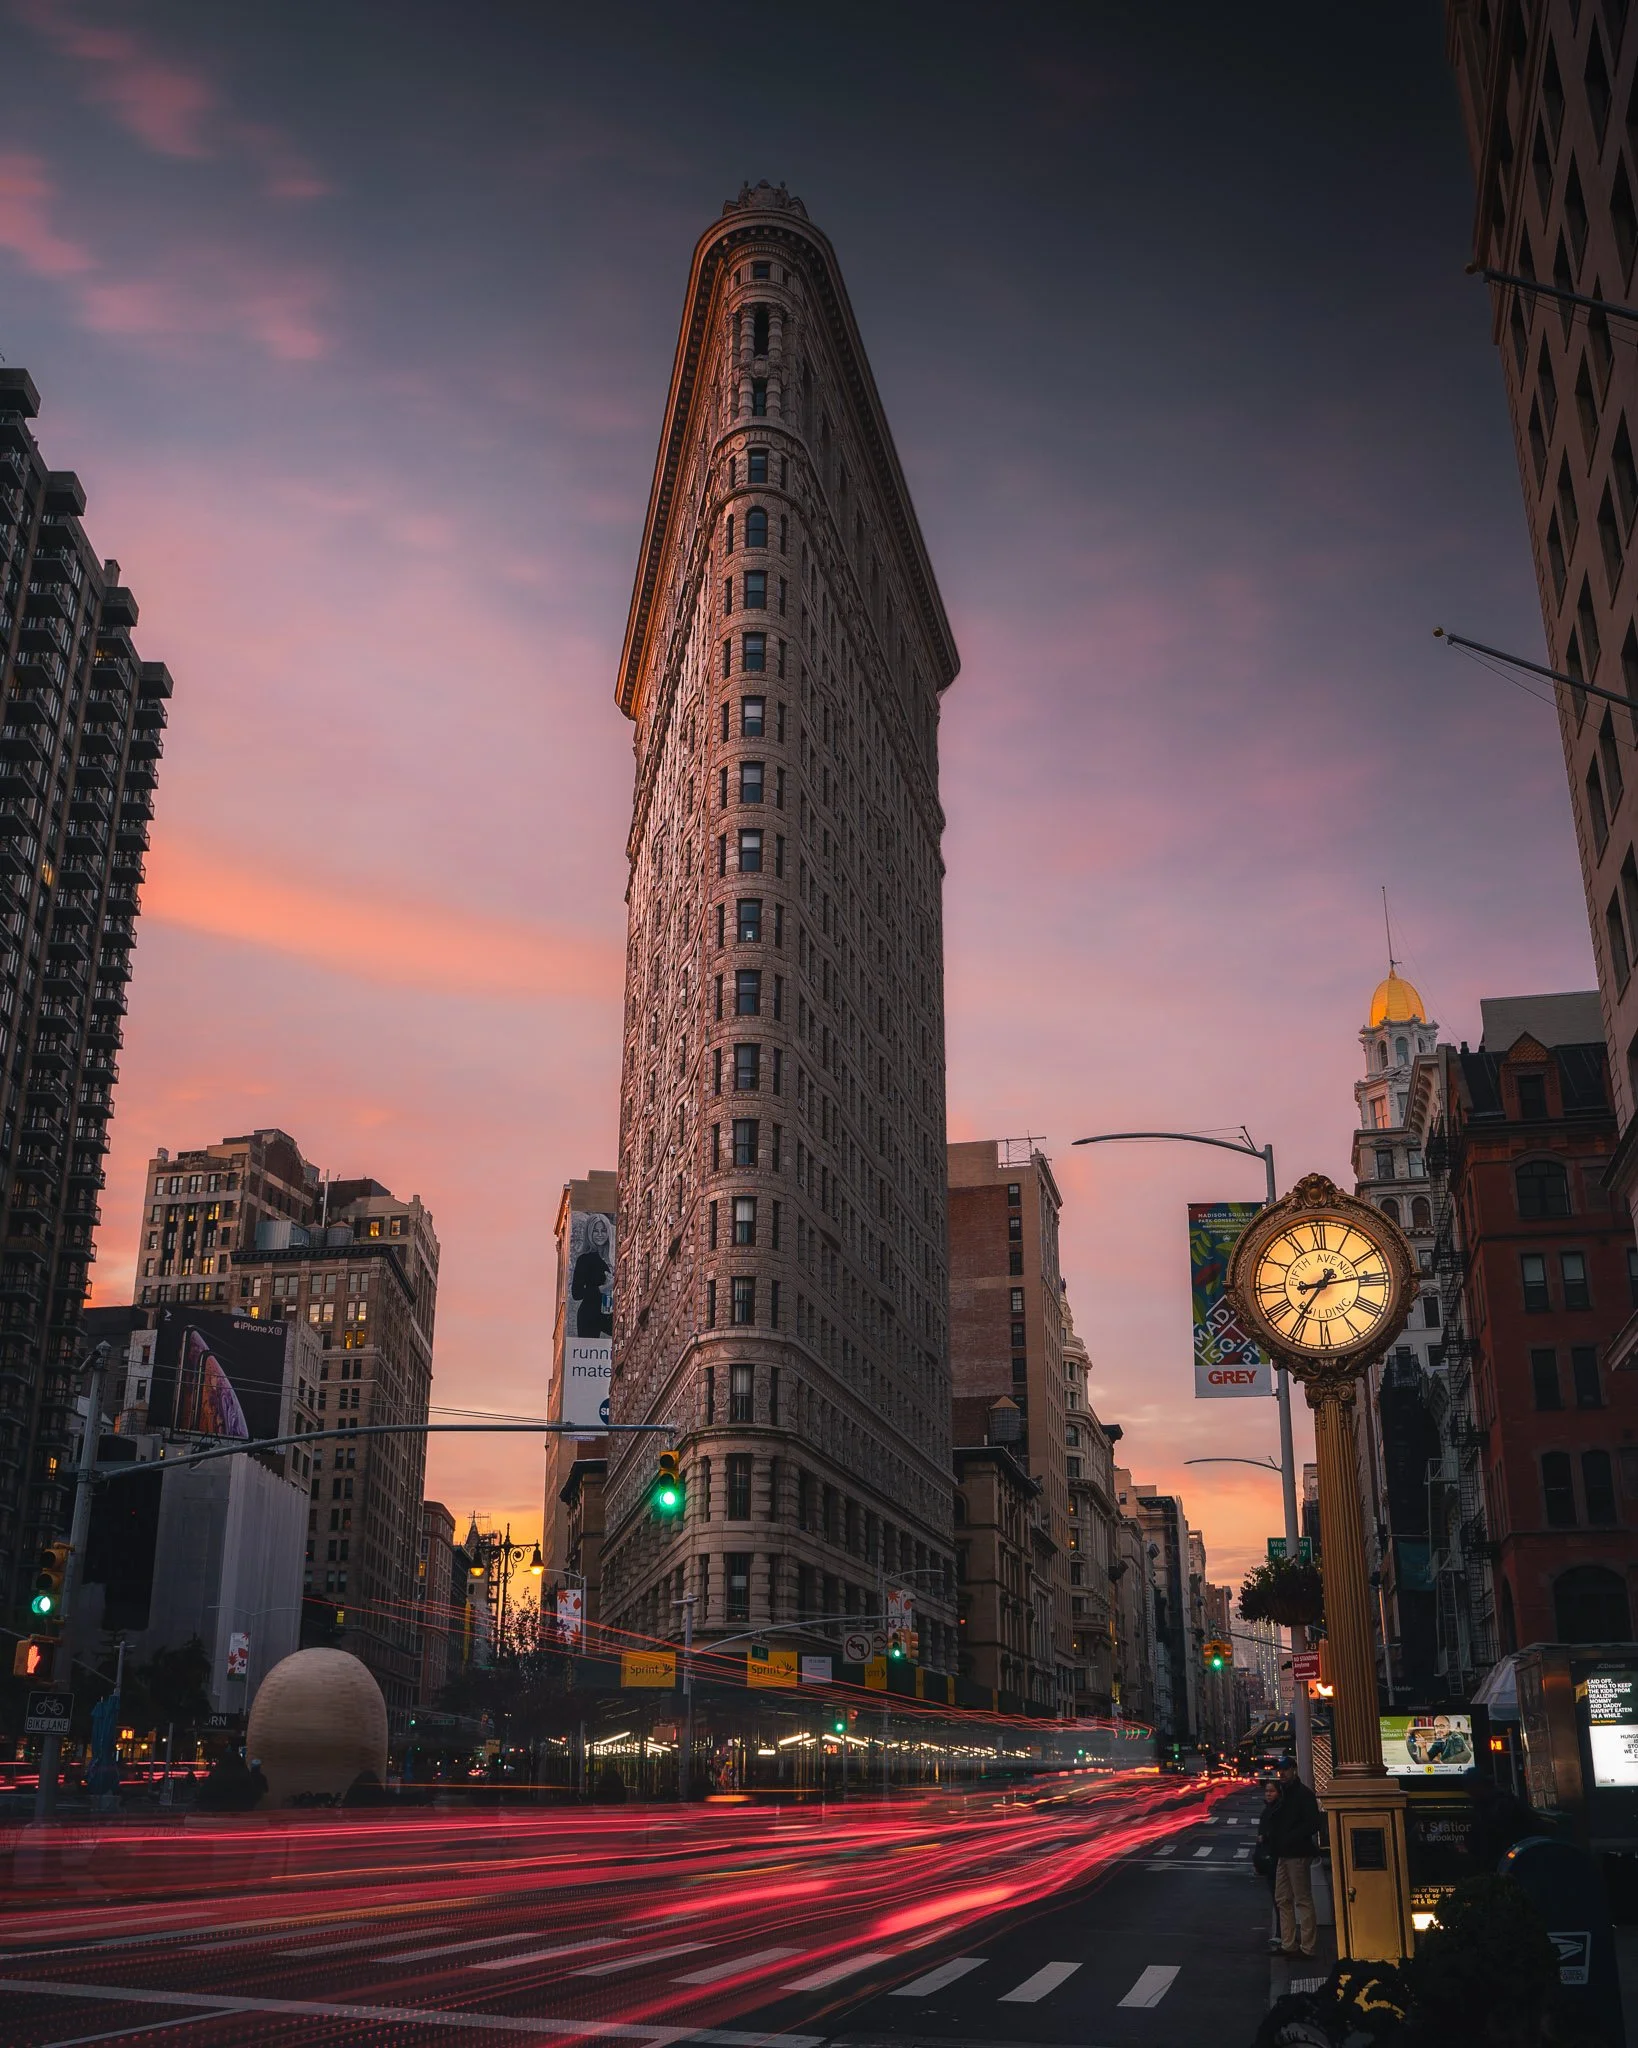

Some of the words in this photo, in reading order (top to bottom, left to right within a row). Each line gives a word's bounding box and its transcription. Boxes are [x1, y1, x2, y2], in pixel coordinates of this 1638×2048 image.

[1289, 1257, 1311, 1287] FIFTH
[1316, 1253, 1355, 1280] AVENUE
[240, 1321, 267, 1333] iPhone
[1208, 1370, 1257, 1385] GREY
[1270, 1540, 1287, 1548] Wes
[630, 1664, 659, 1676] Sprint
[751, 1664, 780, 1676] Sprint
[27, 1718, 45, 1730] BIKE
[47, 1719, 67, 1731] LANE
[1426, 1834, 1464, 1843] Brooklyn
